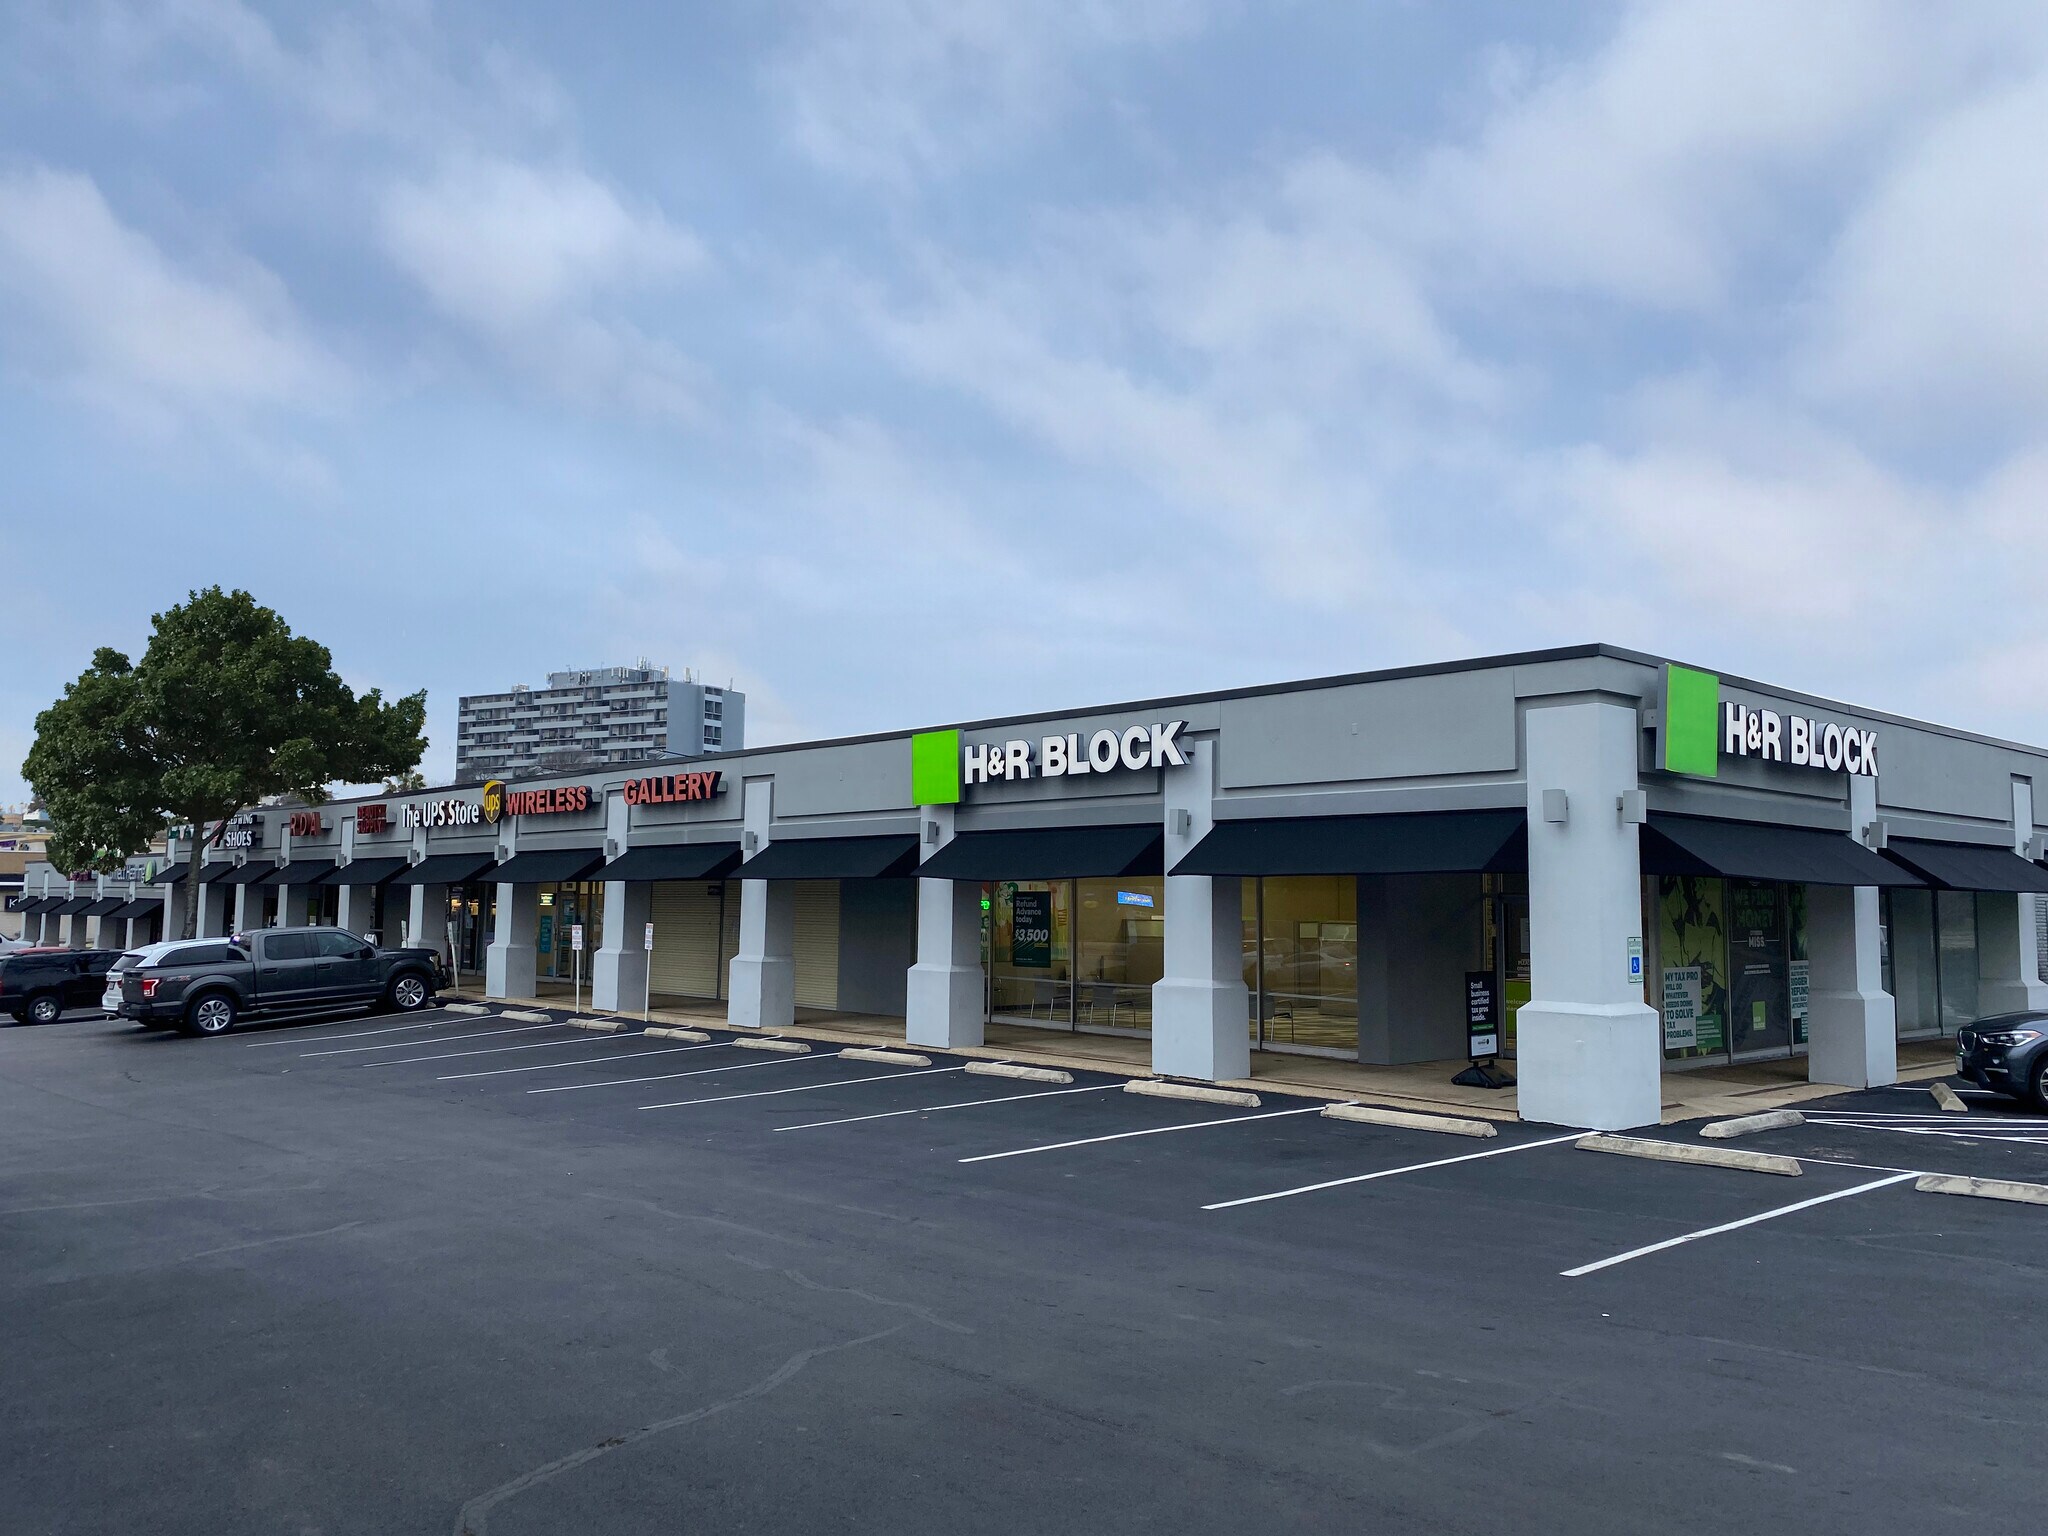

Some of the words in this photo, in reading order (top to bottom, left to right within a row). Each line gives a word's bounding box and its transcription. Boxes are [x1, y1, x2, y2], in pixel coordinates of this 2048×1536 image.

[1724, 701, 1782, 761] H&R
[1789, 715, 1879, 777] BLOCK
[964, 739, 1033, 784] H&R
[1042, 720, 1187, 777] BLOCK
[624, 771, 717, 805] GALLERY
[485, 793, 500, 817] ups
[507, 785, 588, 816] WIRELESS
[401, 804, 420, 828] The
[422, 802, 445, 827] UPS
[448, 799, 479, 826] Store
[290, 812, 318, 836] RDA
[357, 820, 383, 834] SUPPLY
[226, 831, 252, 847] SHOES
[1015, 900, 1037, 908] Refund
[1015, 916, 1033, 924] today
[1015, 928, 1049, 942] $3,500
[1664, 972, 1674, 981] MY
[1675, 972, 1686, 981] TAX
[1686, 971, 1698, 980] PRO
[1470, 981, 1483, 989] Small
[1665, 983, 1676, 991] WILL
[1470, 989, 1490, 997] business
[1470, 997, 1489, 1006] certified
[1479, 1006, 1488, 1015] pros
[1666, 1010, 1675, 1020] TO
[1675, 1008, 1694, 1019] SOLVE
[1666, 1021, 1676, 1029] TAX
